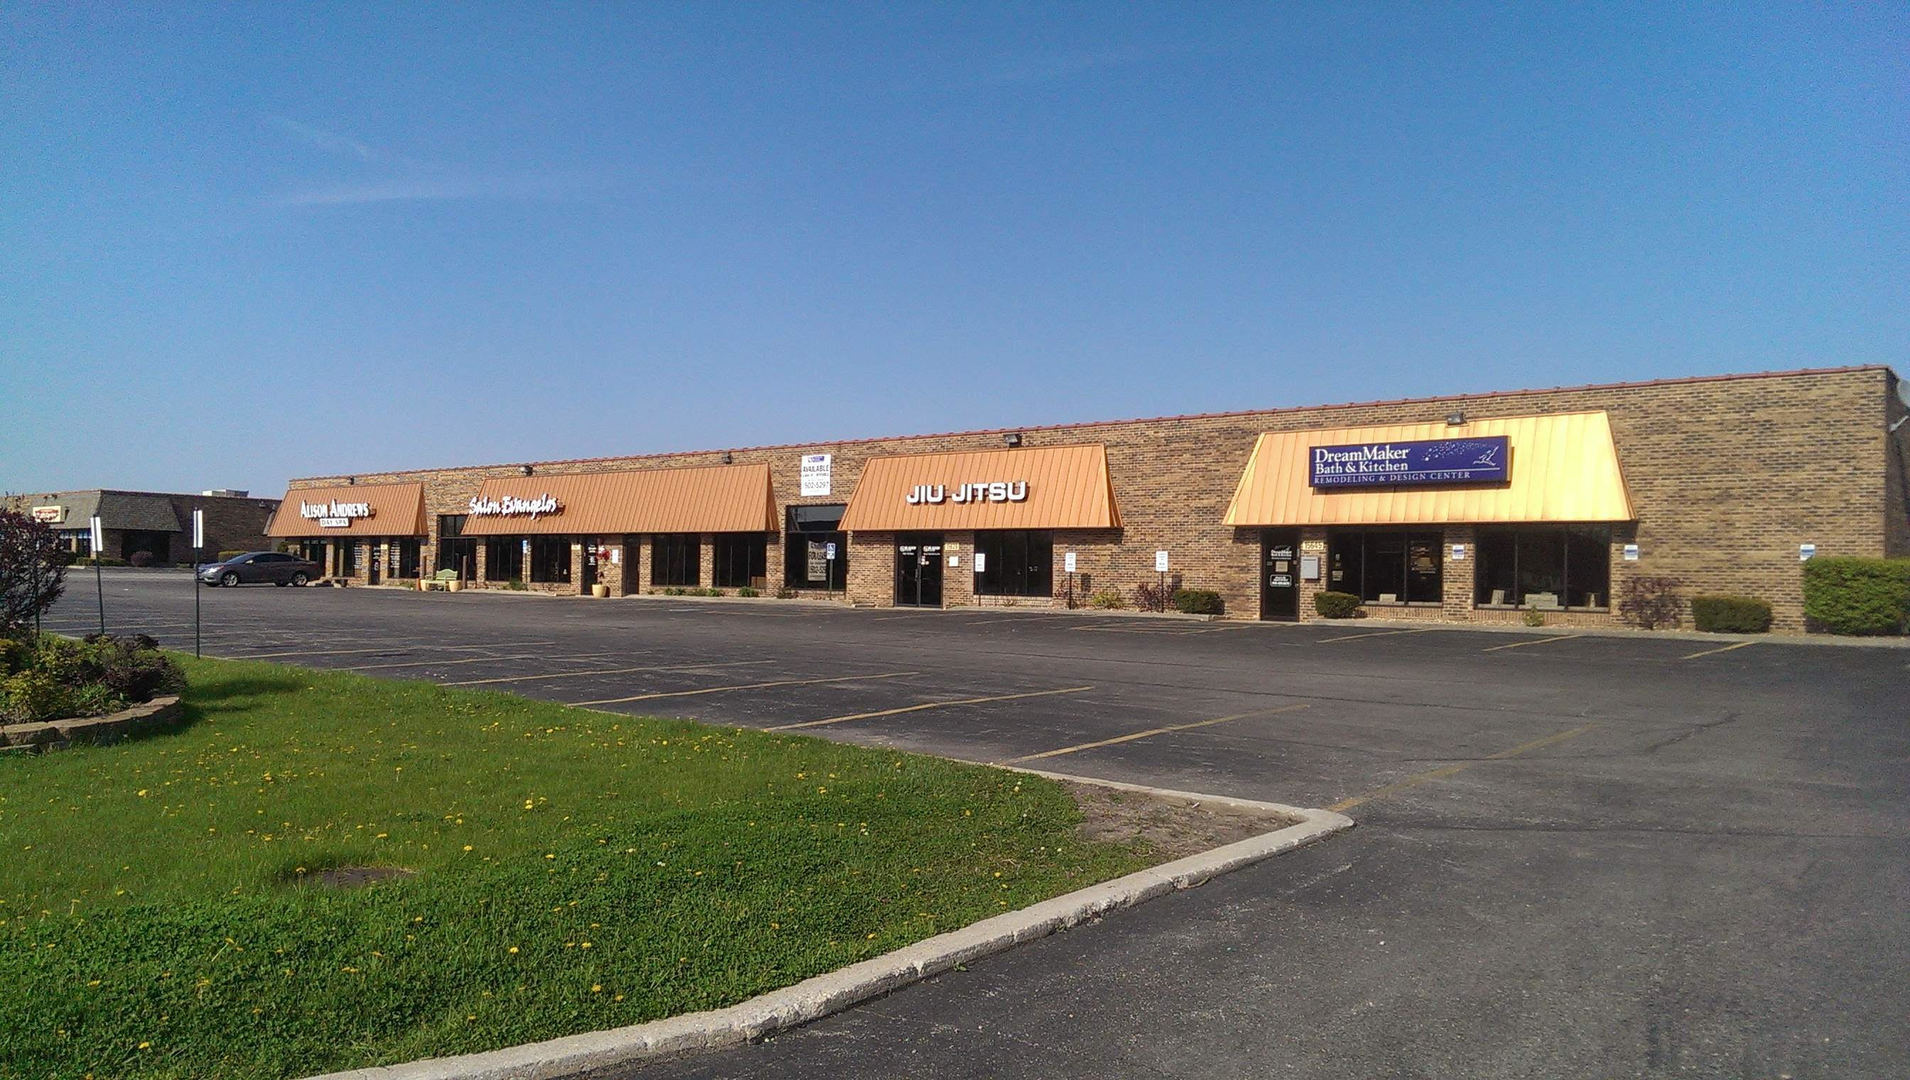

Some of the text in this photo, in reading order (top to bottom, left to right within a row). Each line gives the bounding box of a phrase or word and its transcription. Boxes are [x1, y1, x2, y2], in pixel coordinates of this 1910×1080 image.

[1315, 445, 1410, 463] DreamMaker
[803, 464, 829, 472] AVAILABLE
[1315, 460, 1408, 474] Bath & Kitchen
[1314, 475, 1375, 484] REMODELING
[1390, 472, 1426, 481] DESIGN
[1430, 471, 1471, 480] CENTER
[301, 499, 369, 518] ALISON ANDREWS
[469, 496, 501, 515] Salon
